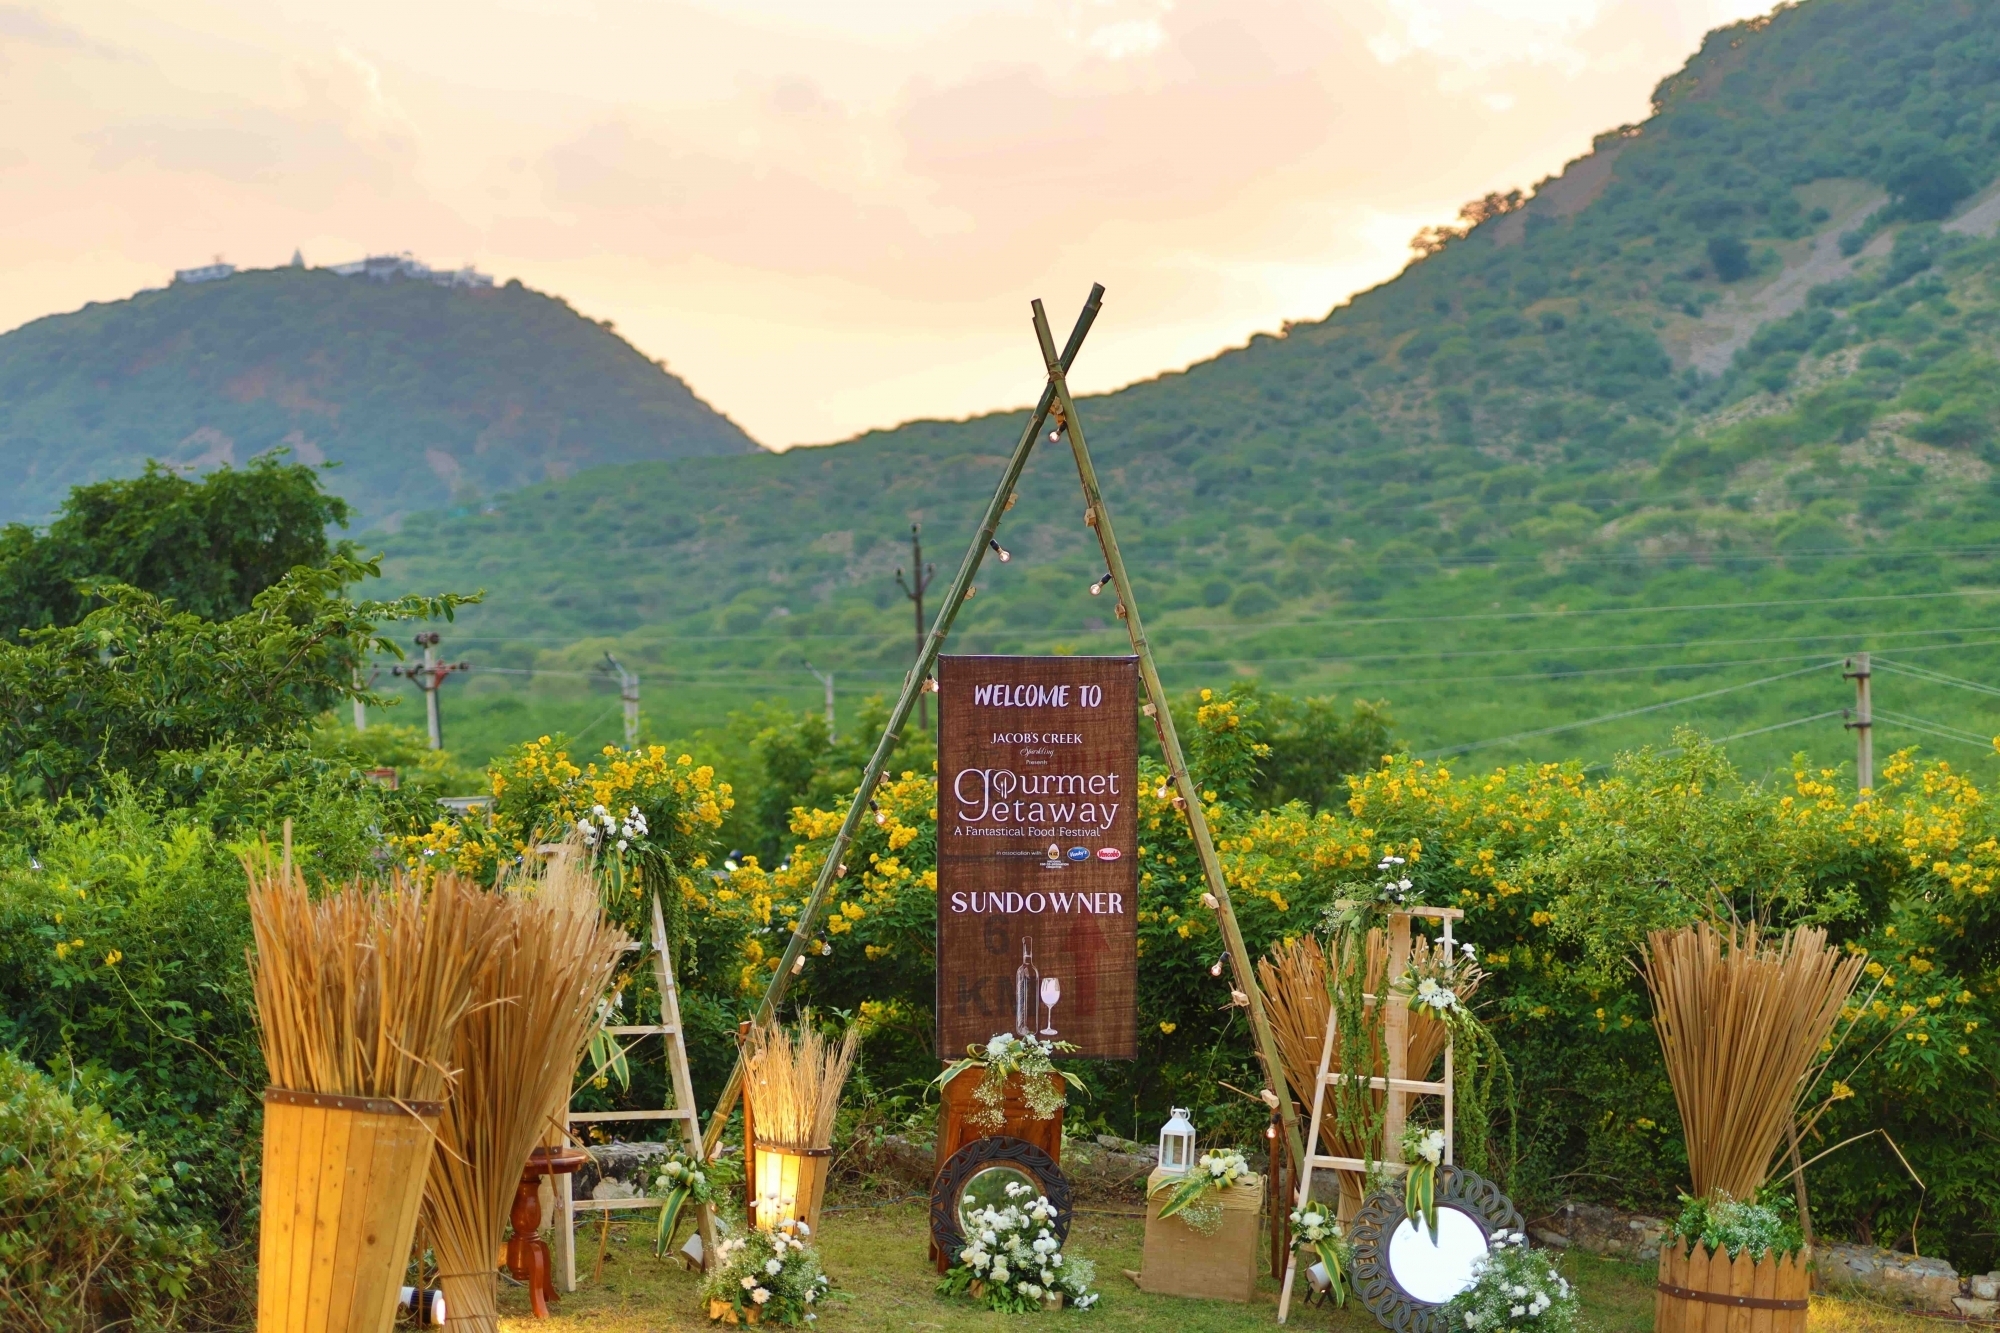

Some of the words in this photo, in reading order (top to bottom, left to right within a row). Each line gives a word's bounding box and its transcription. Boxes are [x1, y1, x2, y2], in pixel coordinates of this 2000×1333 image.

[974, 683, 1071, 707] WELCOME
[1079, 684, 1102, 708] TO
[990, 732, 1039, 744] JACOB'S
[1042, 733, 1083, 744] CREEK
[1019, 746, 1055, 758] Sparkling
[954, 826, 963, 836] A
[966, 826, 1024, 837] Fantastical
[1028, 826, 1055, 837] Food
[1059, 826, 1101, 837] Festival
[951, 891, 1124, 914] SUNDOWNER
